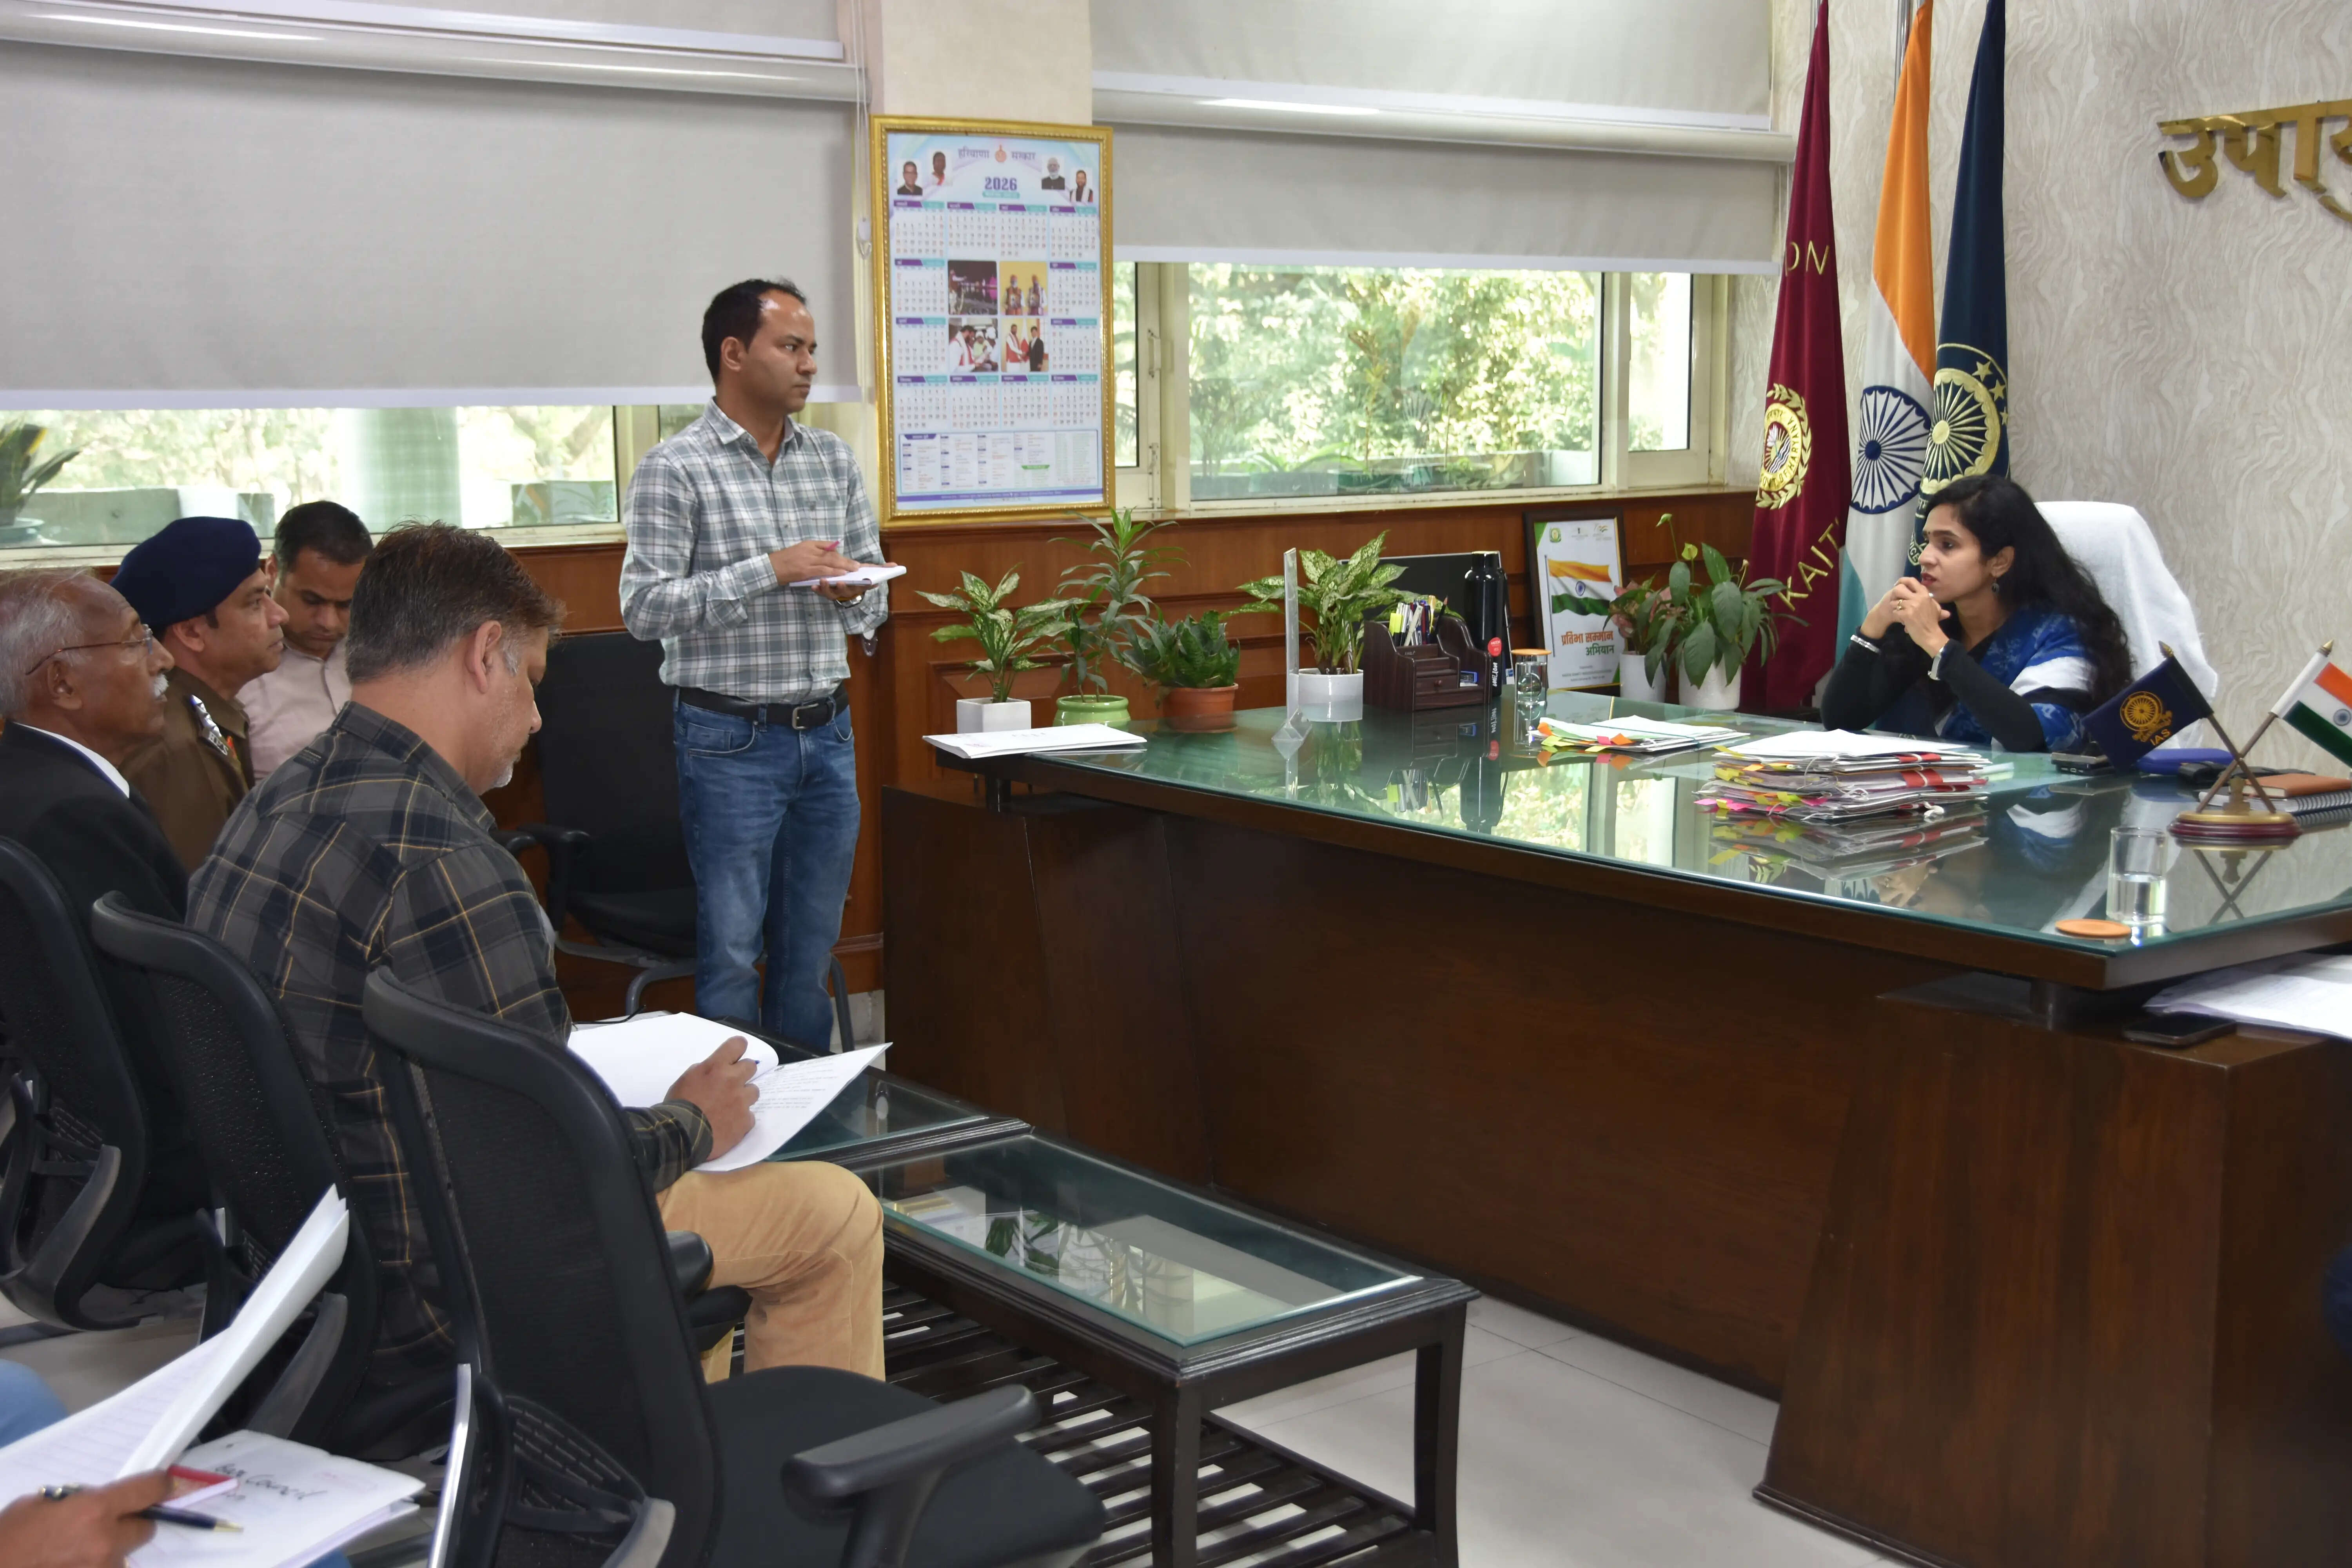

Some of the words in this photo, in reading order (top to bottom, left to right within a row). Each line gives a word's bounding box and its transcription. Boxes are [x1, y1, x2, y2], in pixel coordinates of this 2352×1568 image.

[1011, 151, 1036, 160] सरकार
[985, 176, 1018, 191] 2026
[1779, 469, 1788, 483] OF
[1788, 416, 1799, 470] HARYANA
[1778, 516, 1839, 612] KAIT
[1561, 631, 1584, 646] प्रतिभा
[1585, 631, 1613, 643] सम्मान
[1586, 643, 1615, 656] अभियान
[2150, 729, 2171, 746] IAS
